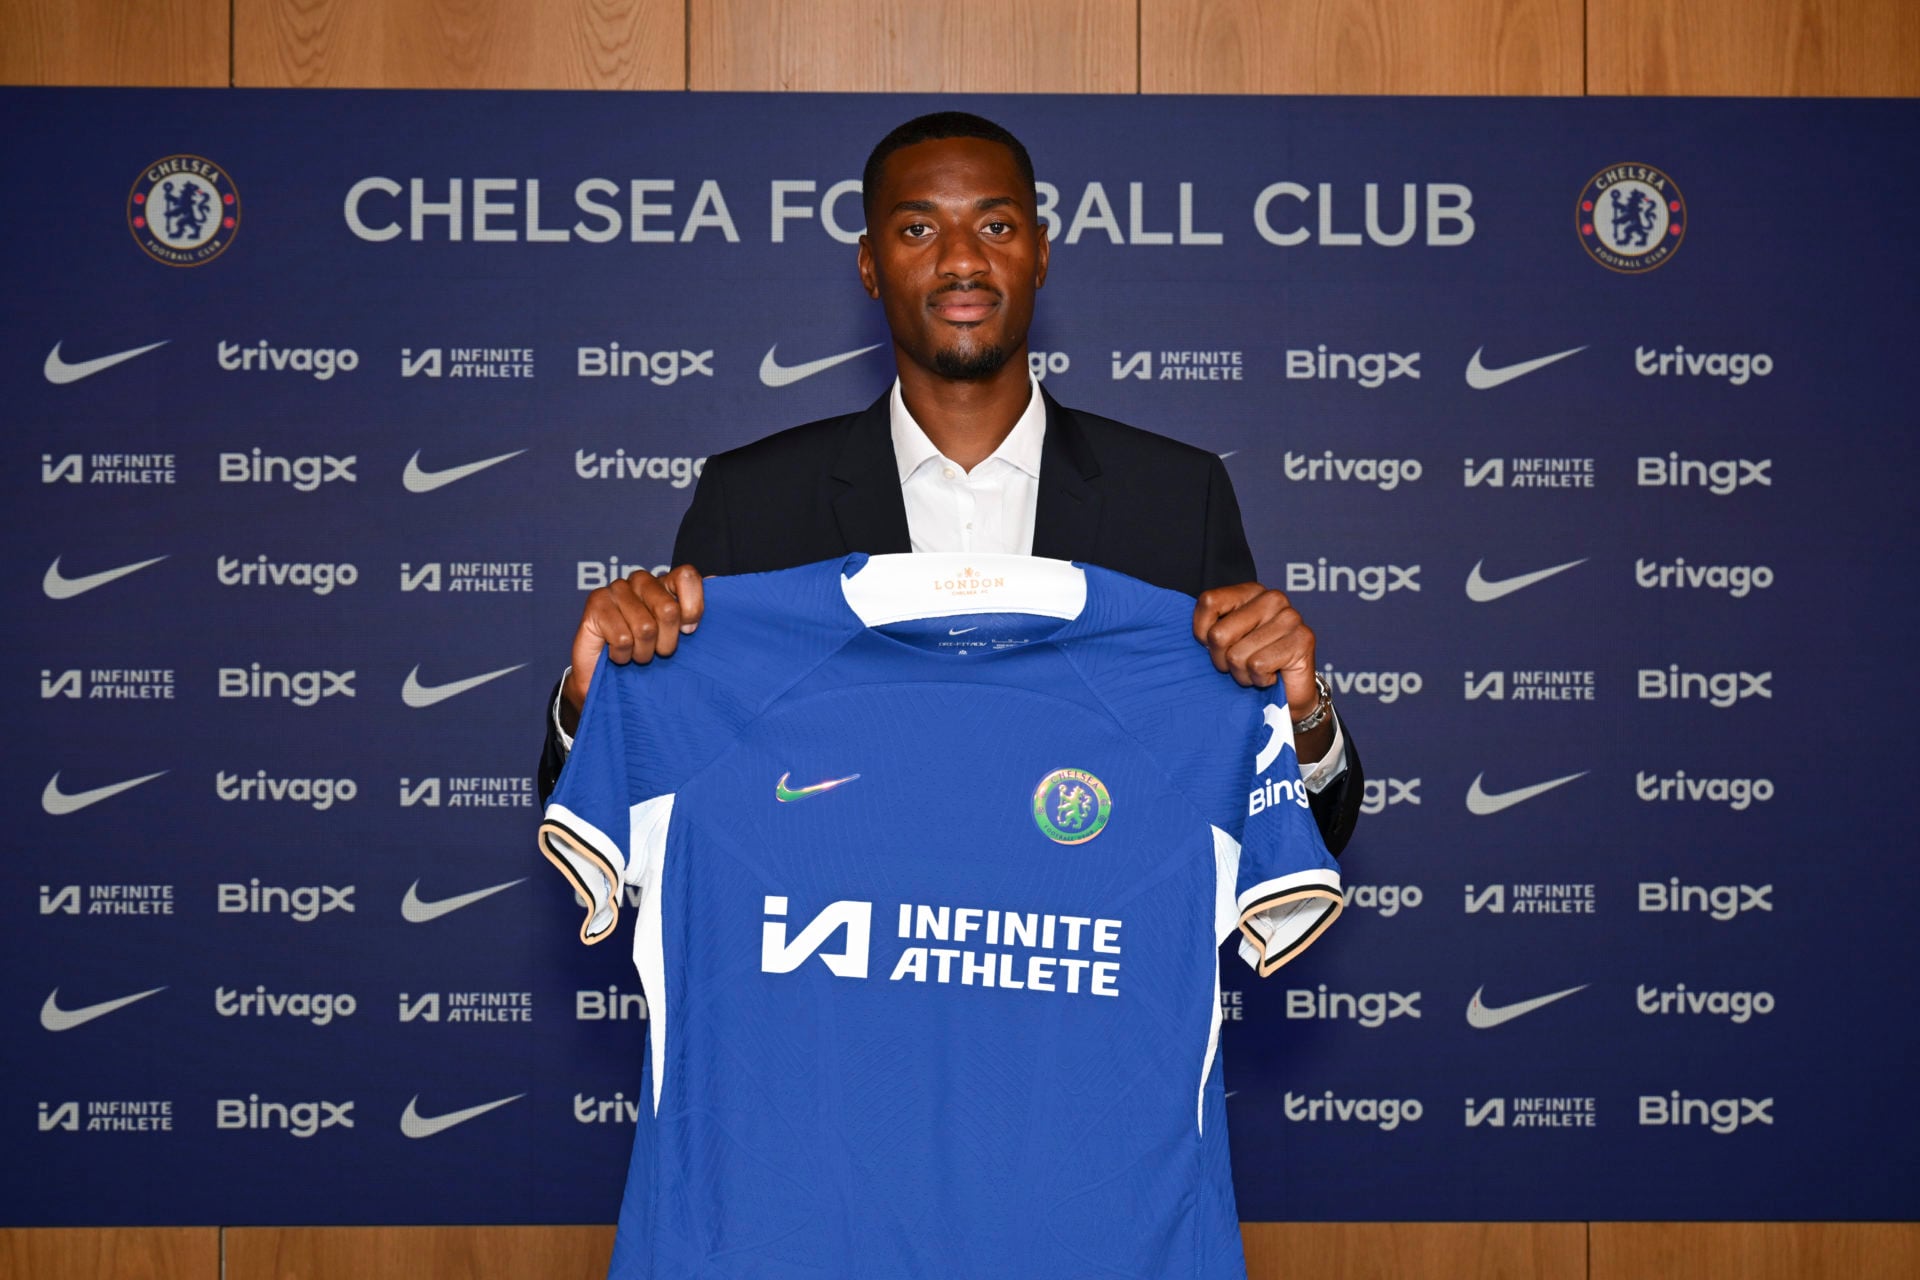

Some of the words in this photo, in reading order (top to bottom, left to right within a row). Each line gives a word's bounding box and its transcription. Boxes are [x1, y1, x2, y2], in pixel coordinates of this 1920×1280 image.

[147, 158, 219, 183] CHELSEA
[1595, 166, 1665, 190] CHELSEA
[345, 177, 740, 242] CHELSEA
[771, 179, 1223, 246] FOBALL
[1254, 182, 1474, 246] CLUB
[1595, 246, 1640, 267] FOOTBALL
[1644, 246, 1667, 264] CLUB
[218, 340, 358, 380] trivago
[450, 348, 533, 361] INFINITE
[1160, 351, 1242, 364] INFINITE
[450, 361, 533, 378] ATHLETE
[1160, 364, 1242, 381] ATHLETE
[1636, 346, 1773, 385] trivago
[91, 454, 175, 467] INFINITE
[1512, 458, 1593, 471] INFINITE
[91, 467, 175, 484] ATHLETE
[1285, 451, 1422, 490] trivago
[1512, 471, 1593, 488] ATHLETE
[218, 555, 358, 595] trivago
[449, 562, 533, 576] INFINITE
[1636, 558, 1773, 597] trivago
[449, 576, 533, 592] ATHLETE
[934, 578, 1004, 590] LONDON
[90, 669, 174, 682] INFINITE
[1322, 663, 1423, 704] ivago
[1513, 671, 1594, 684] INFINITE
[90, 682, 174, 699] ATHLETE
[1513, 684, 1594, 700] ATHLETE
[449, 777, 532, 790] INFINITE
[1050, 770, 1100, 790] CHELSEA
[217, 770, 357, 810] trivago
[449, 790, 532, 807] ATHLETE
[1248, 777, 1311, 817] Bing
[1637, 771, 1774, 810] trivago
[89, 885, 173, 898] INFINITE
[1513, 884, 1594, 897] INFINITE
[89, 898, 173, 915] ATHLETE
[1513, 897, 1594, 914] ATHLETE
[898, 903, 1123, 955] INFINITE
[889, 947, 1121, 998] ATHLETE
[216, 986, 356, 1025] trivago
[448, 992, 531, 1005] INFINITE
[576, 984, 649, 1020] Bin
[1637, 984, 1774, 1023] trivago
[448, 1005, 531, 1022] ATHLETE
[88, 1101, 172, 1114] INFINITE
[573, 1092, 640, 1124] triv
[1285, 1091, 1423, 1130] trivago
[1514, 1097, 1595, 1110] INFINITE
[88, 1114, 172, 1131] ATHLETE
[1514, 1110, 1595, 1127] ATHLETE
